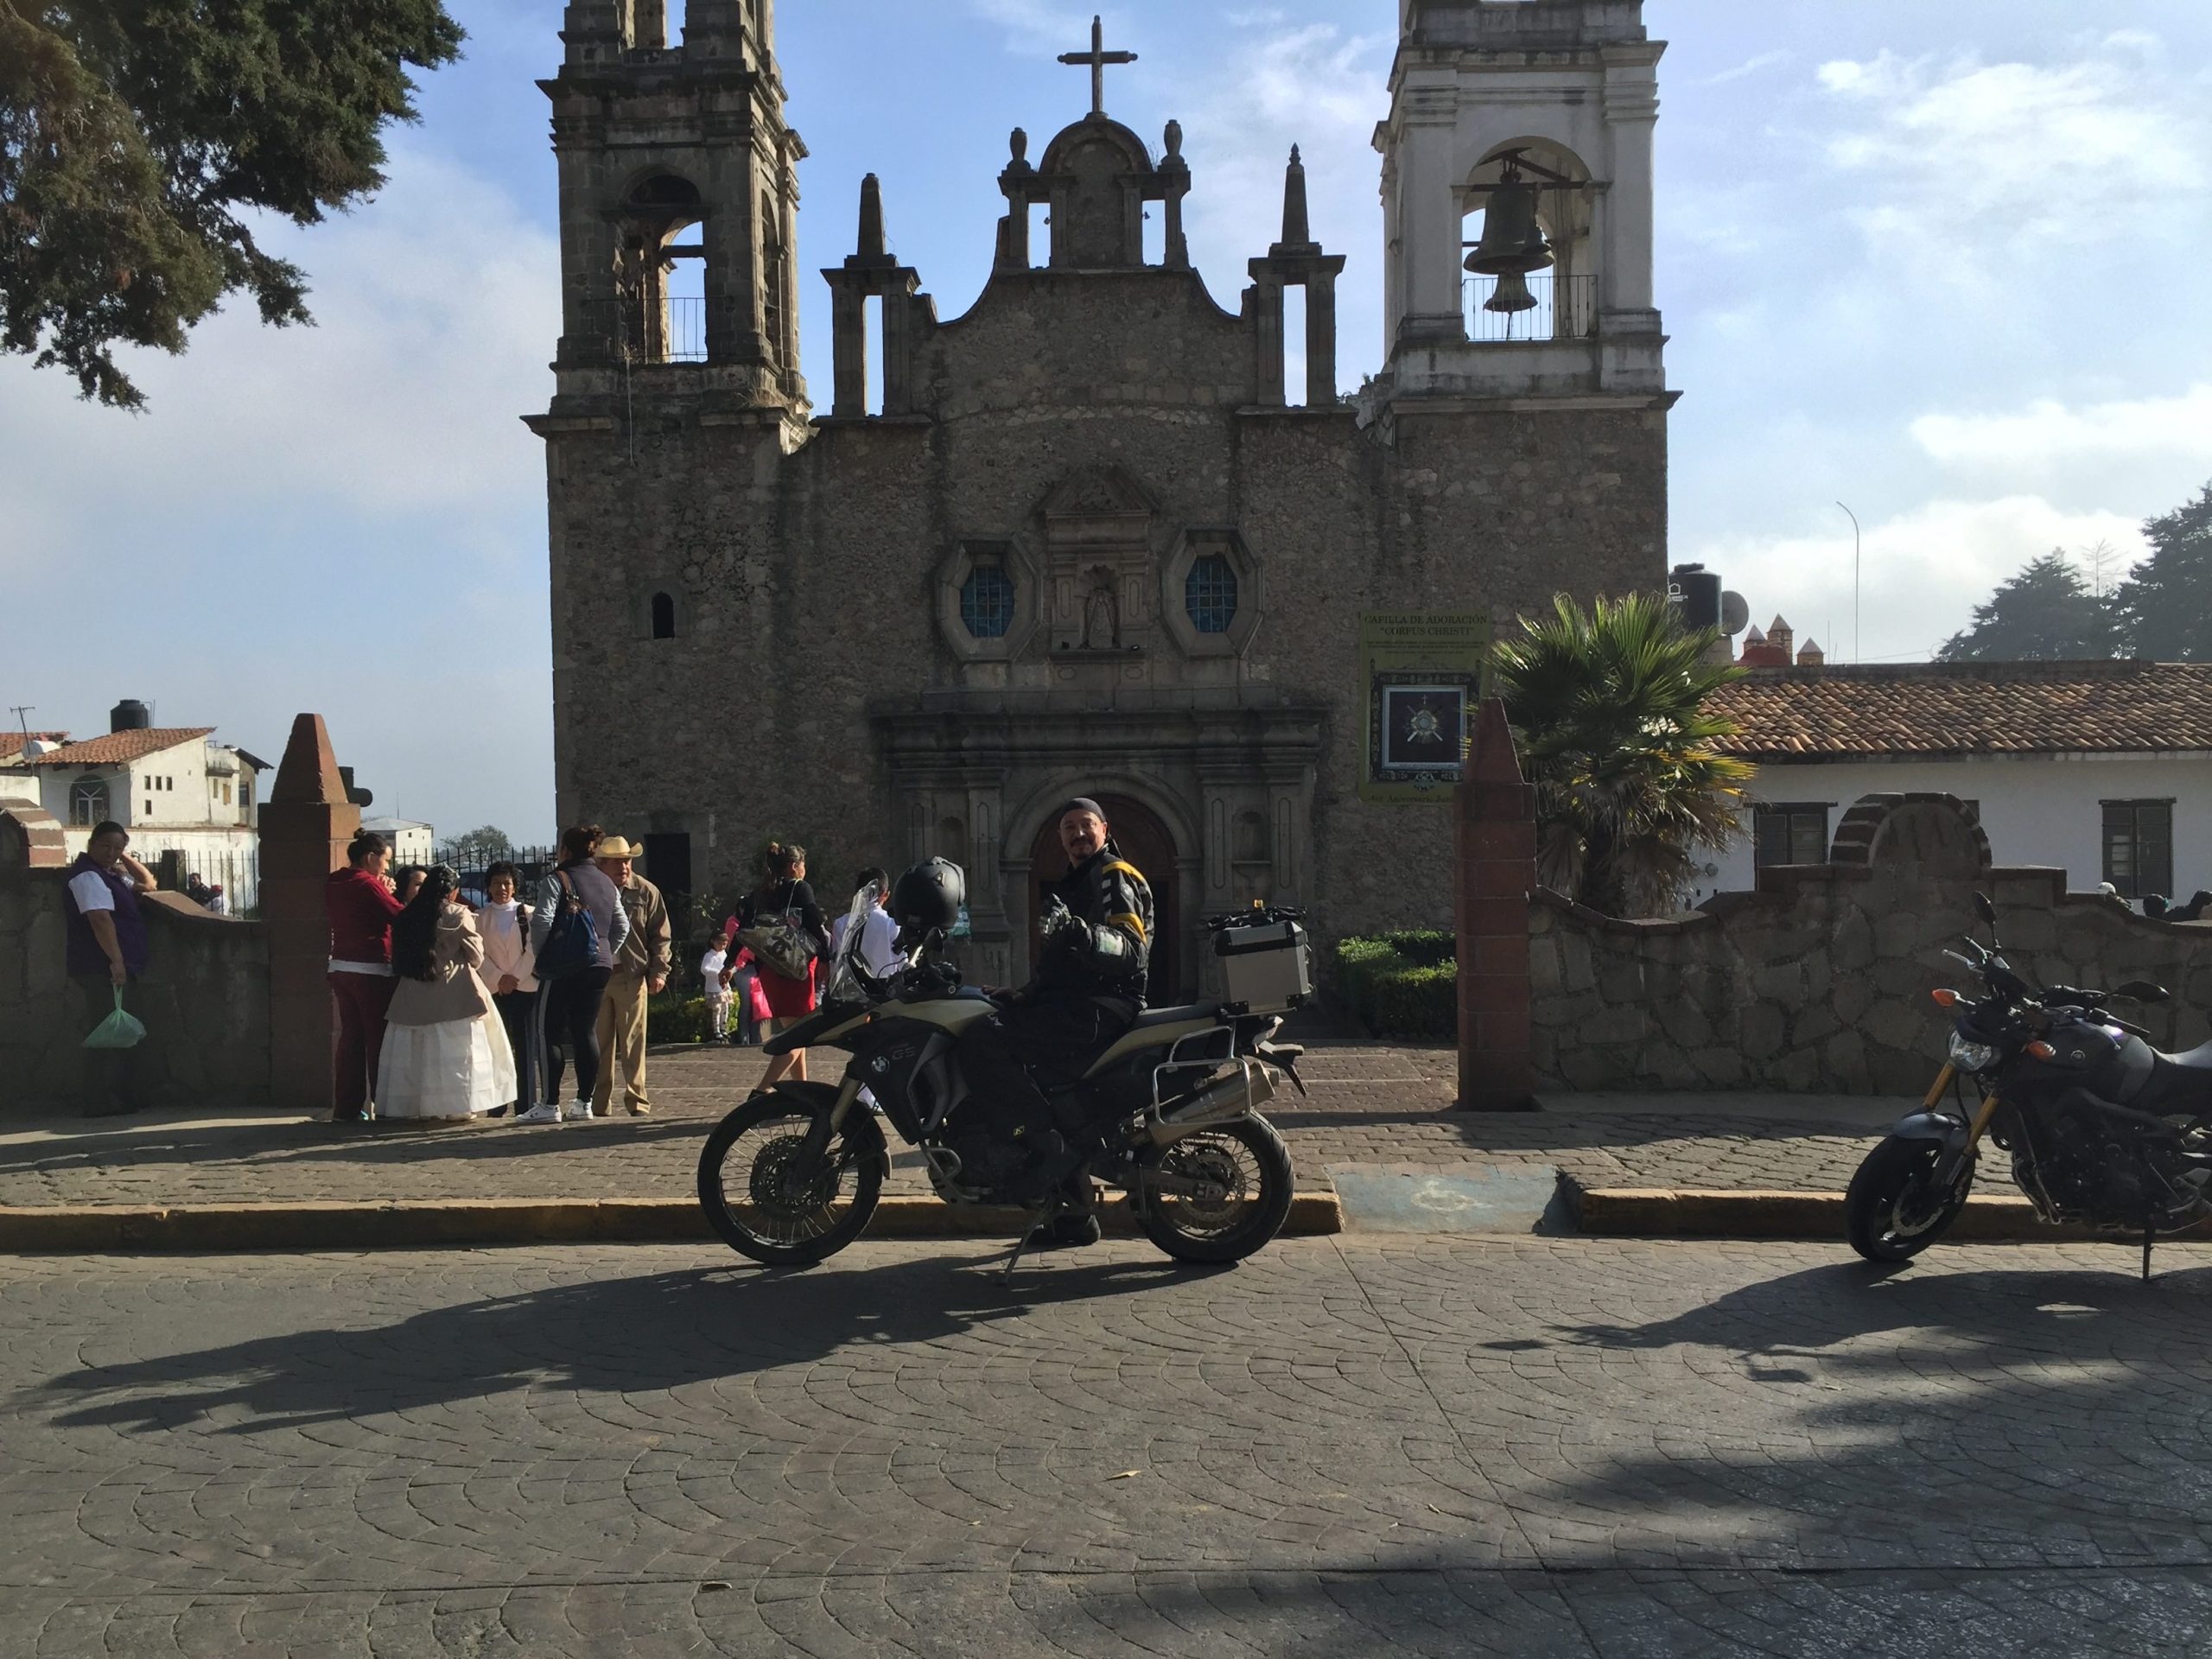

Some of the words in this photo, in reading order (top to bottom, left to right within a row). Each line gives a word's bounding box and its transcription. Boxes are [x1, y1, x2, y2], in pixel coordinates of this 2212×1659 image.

[1363, 614, 1408, 624] CAPILLA
[1410, 614, 1424, 624] DE
[1427, 613, 1487, 624] ADORACIÓN
